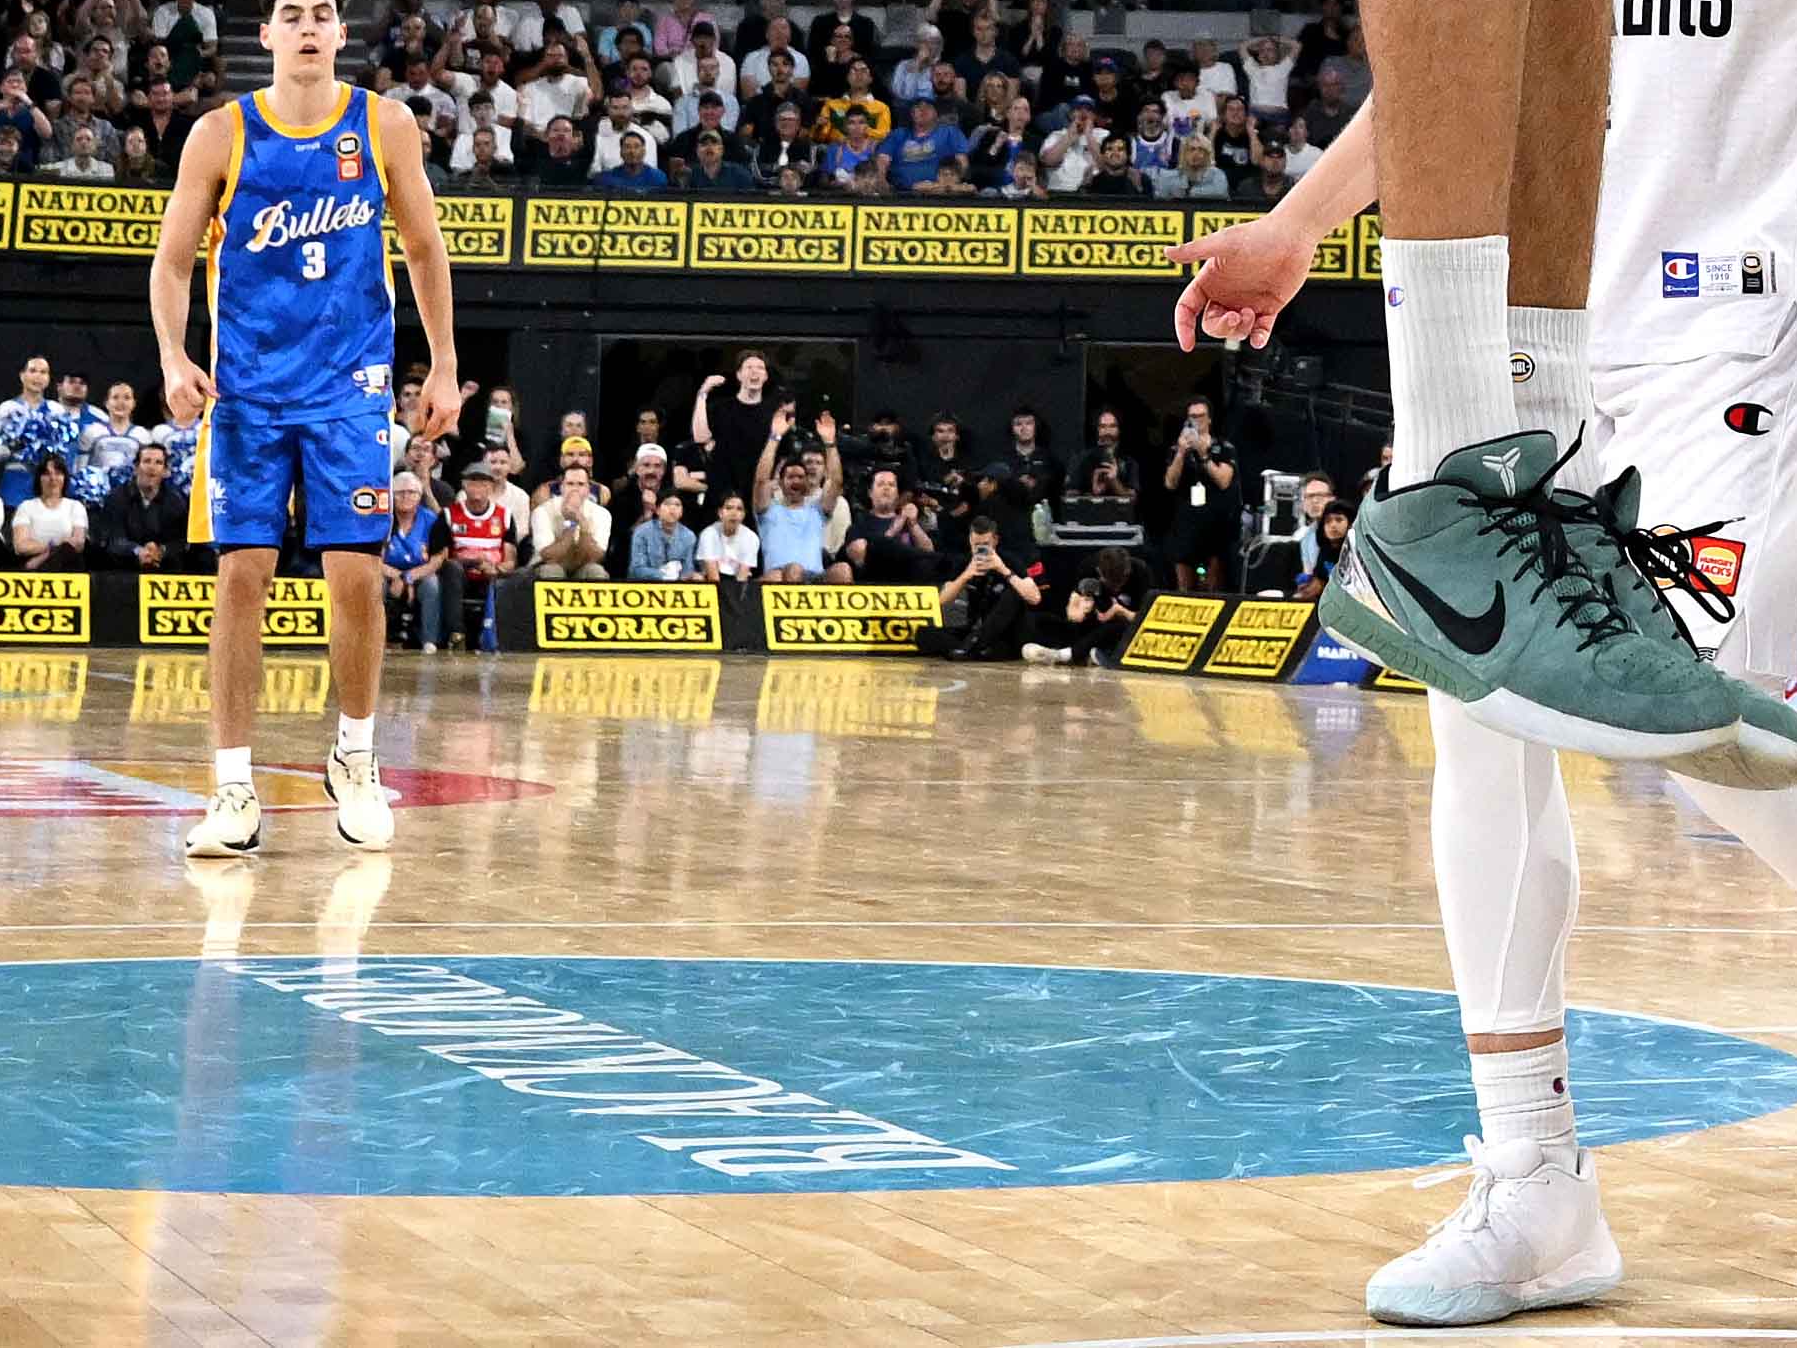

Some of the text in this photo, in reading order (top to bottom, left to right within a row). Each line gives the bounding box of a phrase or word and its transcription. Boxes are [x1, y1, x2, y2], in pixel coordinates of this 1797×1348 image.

[245, 194, 374, 252] Bullets
[533, 205, 680, 227] NATIONAL
[700, 206, 848, 232] NATIONAL
[864, 210, 1011, 235] NATIONAL
[1028, 212, 1176, 239] NATIONAL
[535, 232, 673, 258] STORAGE
[700, 237, 838, 265] STORAGE
[868, 241, 1001, 267] STORAGE
[302, 241, 325, 279] 3
[543, 586, 710, 610] NATIONAL
[772, 589, 934, 613] NATIONAL
[549, 616, 708, 643] STORAGE
[778, 619, 927, 645] STORAGE
[224, 962, 1019, 1177] BLACKMORES
